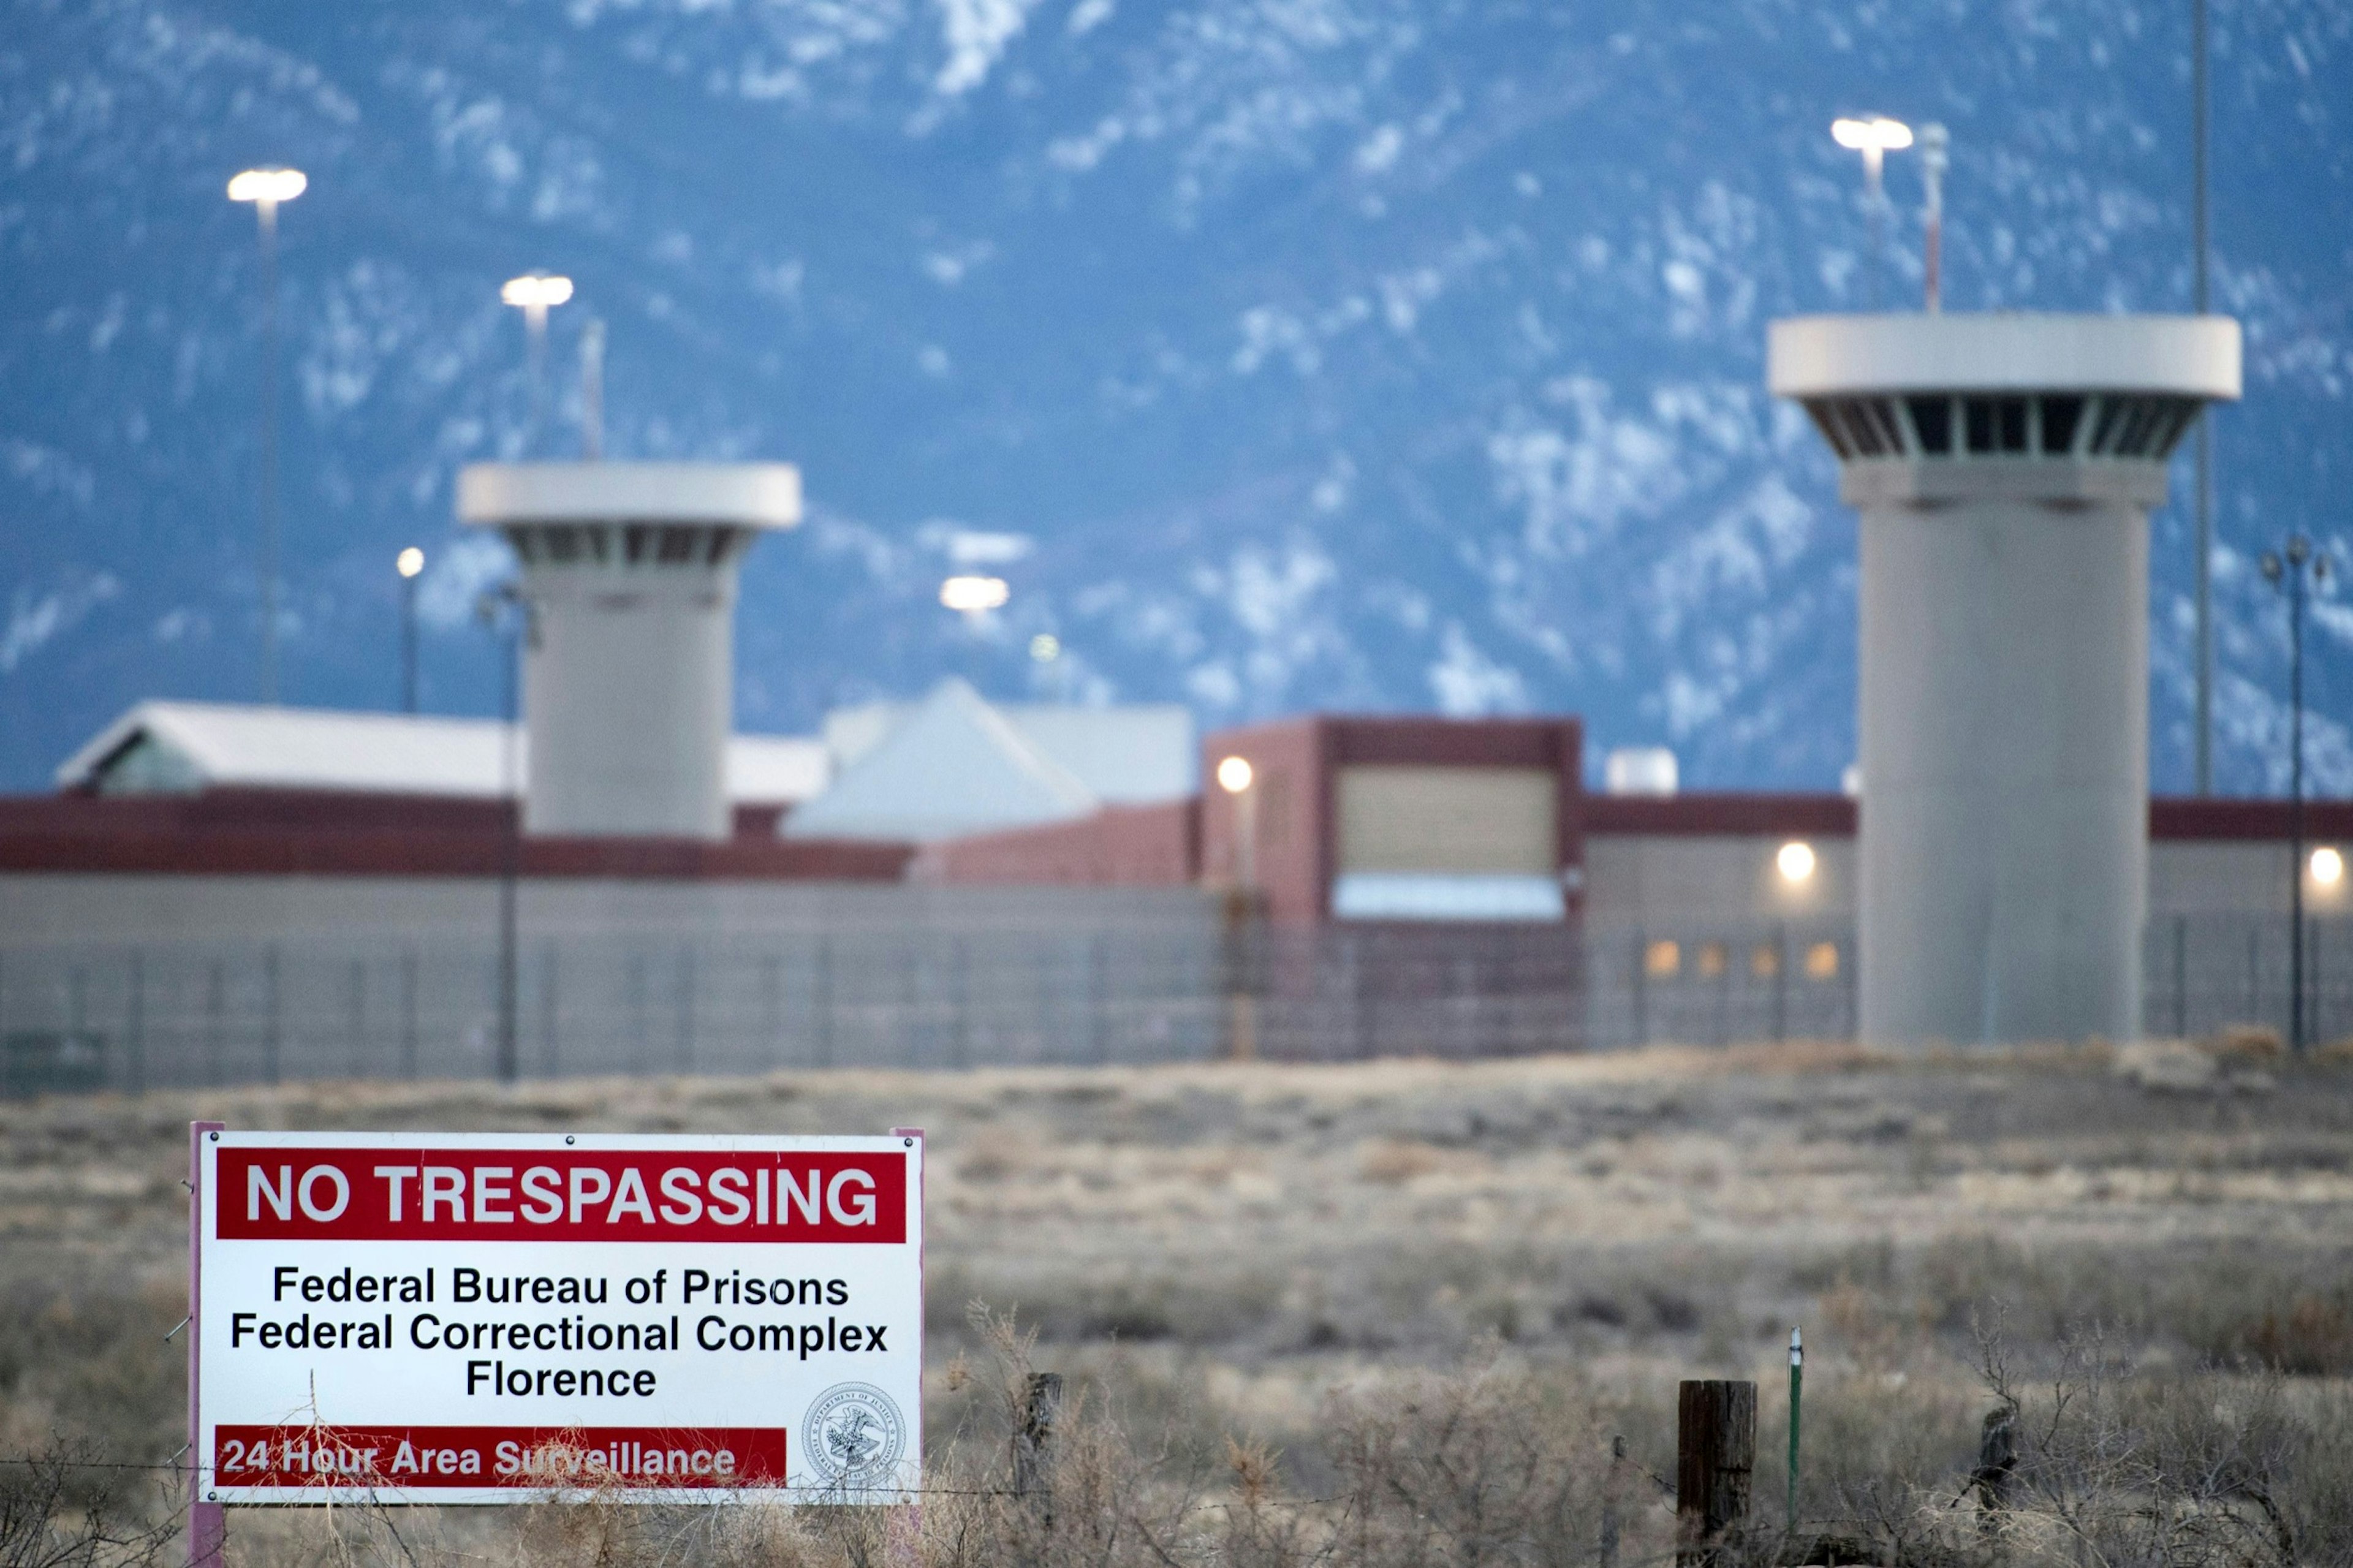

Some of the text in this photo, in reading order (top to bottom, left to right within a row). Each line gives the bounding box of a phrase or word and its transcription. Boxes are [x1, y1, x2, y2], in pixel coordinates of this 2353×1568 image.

[248, 1164, 876, 1226] NO TRESPASSING
[274, 1267, 849, 1306] Federal Bureau of Prisons
[232, 1312, 888, 1361] Federal Correctional Complex
[467, 1360, 657, 1396] Florence
[814, 1393, 855, 1425] DEPARTMENT
[871, 1398, 893, 1425] JUSTICE
[222, 1439, 270, 1472] 24
[282, 1439, 379, 1474] Hour
[390, 1440, 481, 1474] Area
